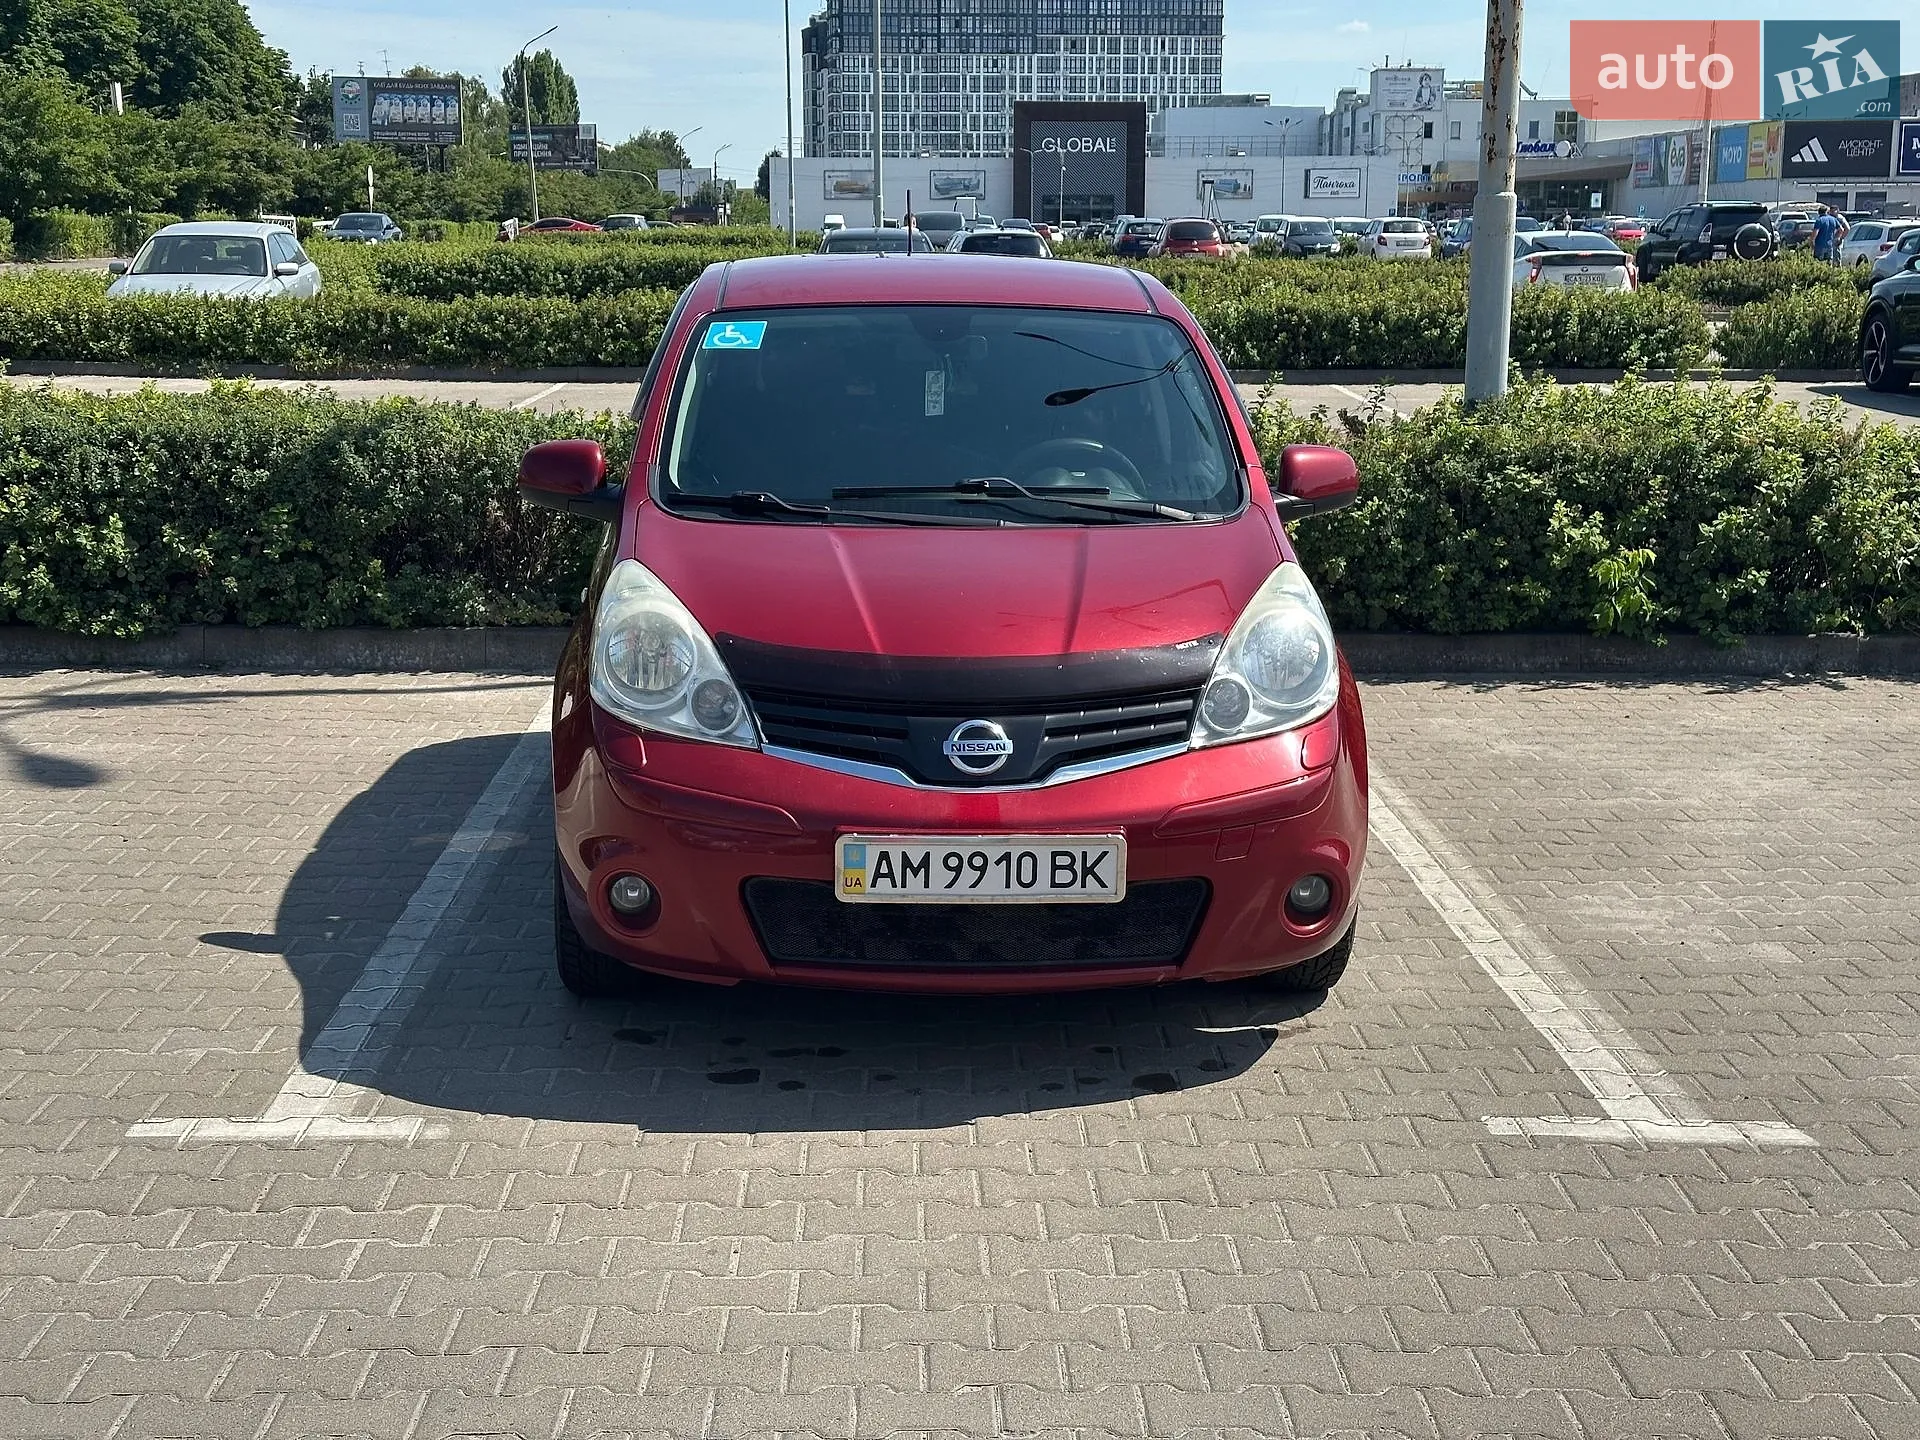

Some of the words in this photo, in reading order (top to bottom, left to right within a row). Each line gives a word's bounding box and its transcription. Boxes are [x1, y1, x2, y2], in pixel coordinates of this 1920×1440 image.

[1041, 137, 1116, 153] GLOBAL
[1838, 139, 1884, 149] ДИСКОНТ-
[1722, 146, 1742, 164] MOYO
[1846, 148, 1875, 157] ЦЕНТР
[951, 743, 1006, 752] NISSAN
[869, 850, 931, 889] AM
[942, 850, 1038, 890] 9910
[1049, 850, 1110, 889] BK
[844, 877, 863, 888] UA
